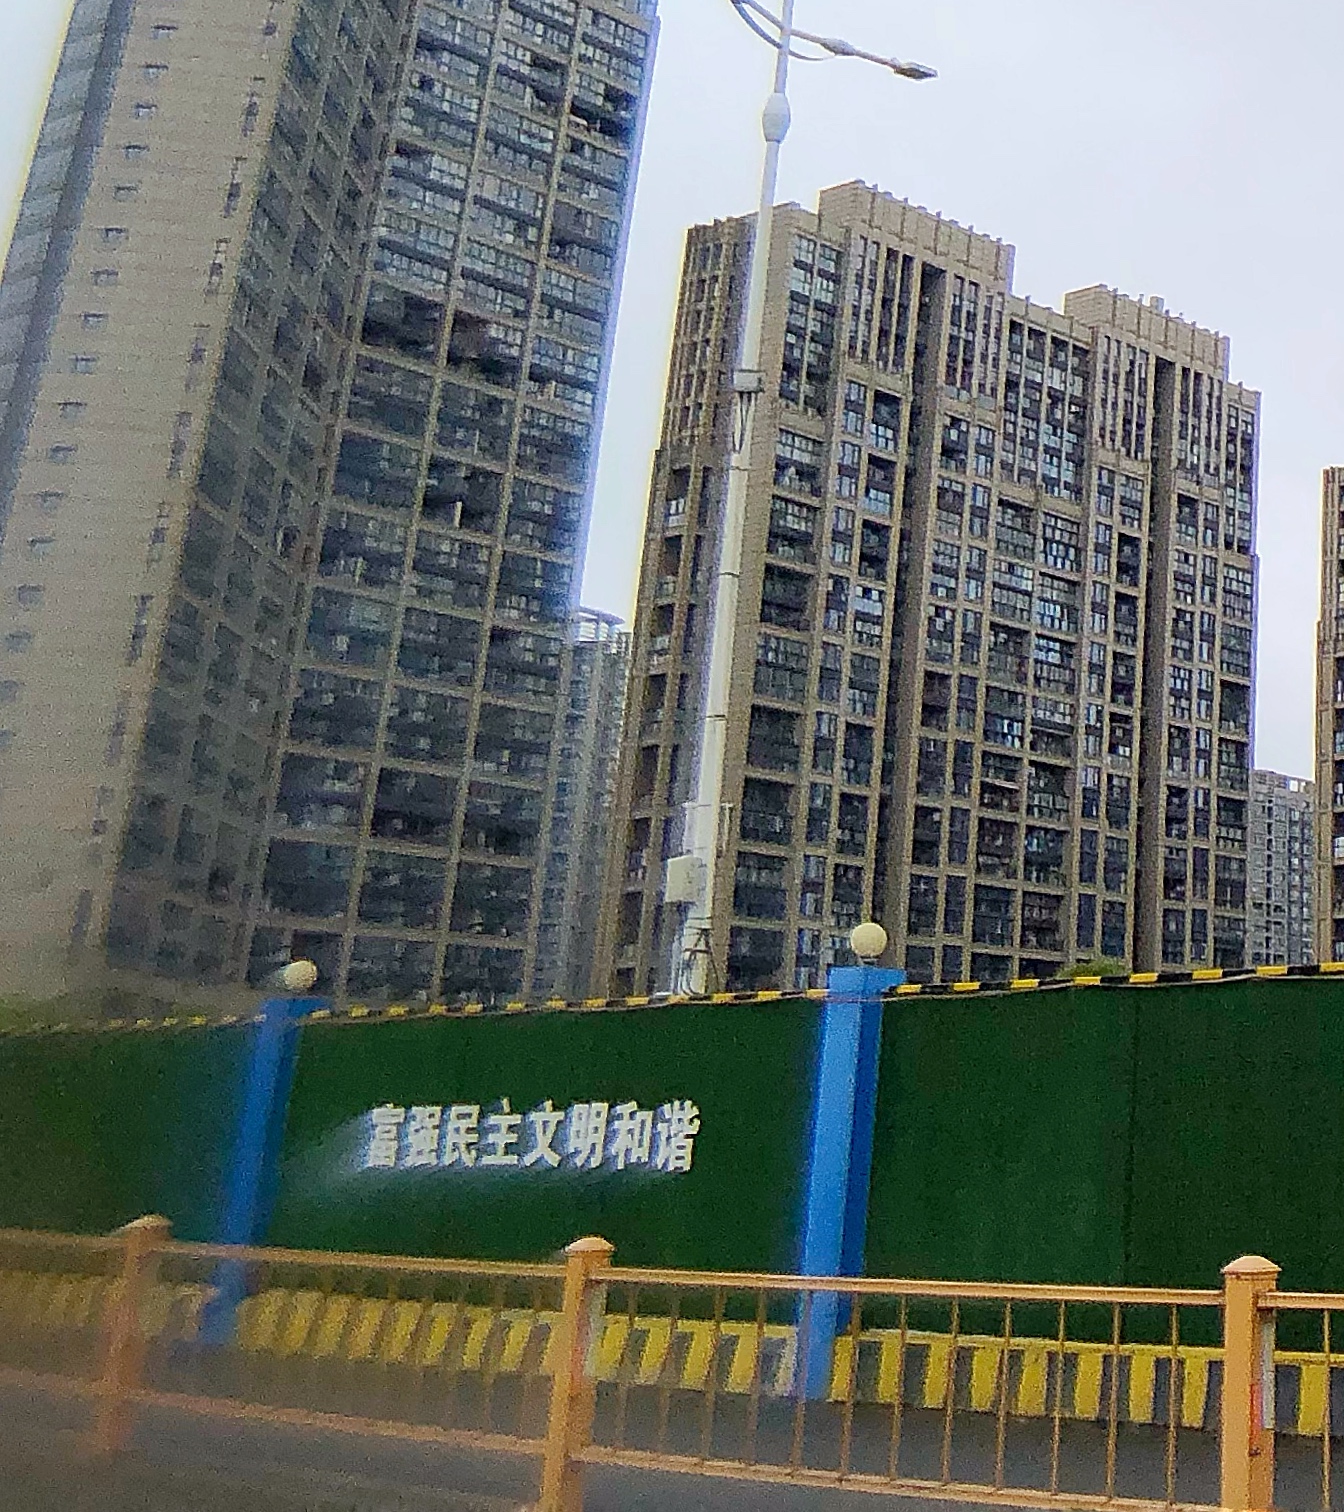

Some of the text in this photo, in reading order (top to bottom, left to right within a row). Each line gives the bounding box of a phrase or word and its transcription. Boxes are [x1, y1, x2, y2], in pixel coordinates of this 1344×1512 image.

[367, 1099, 701, 1171] 富强民主文明和谐
